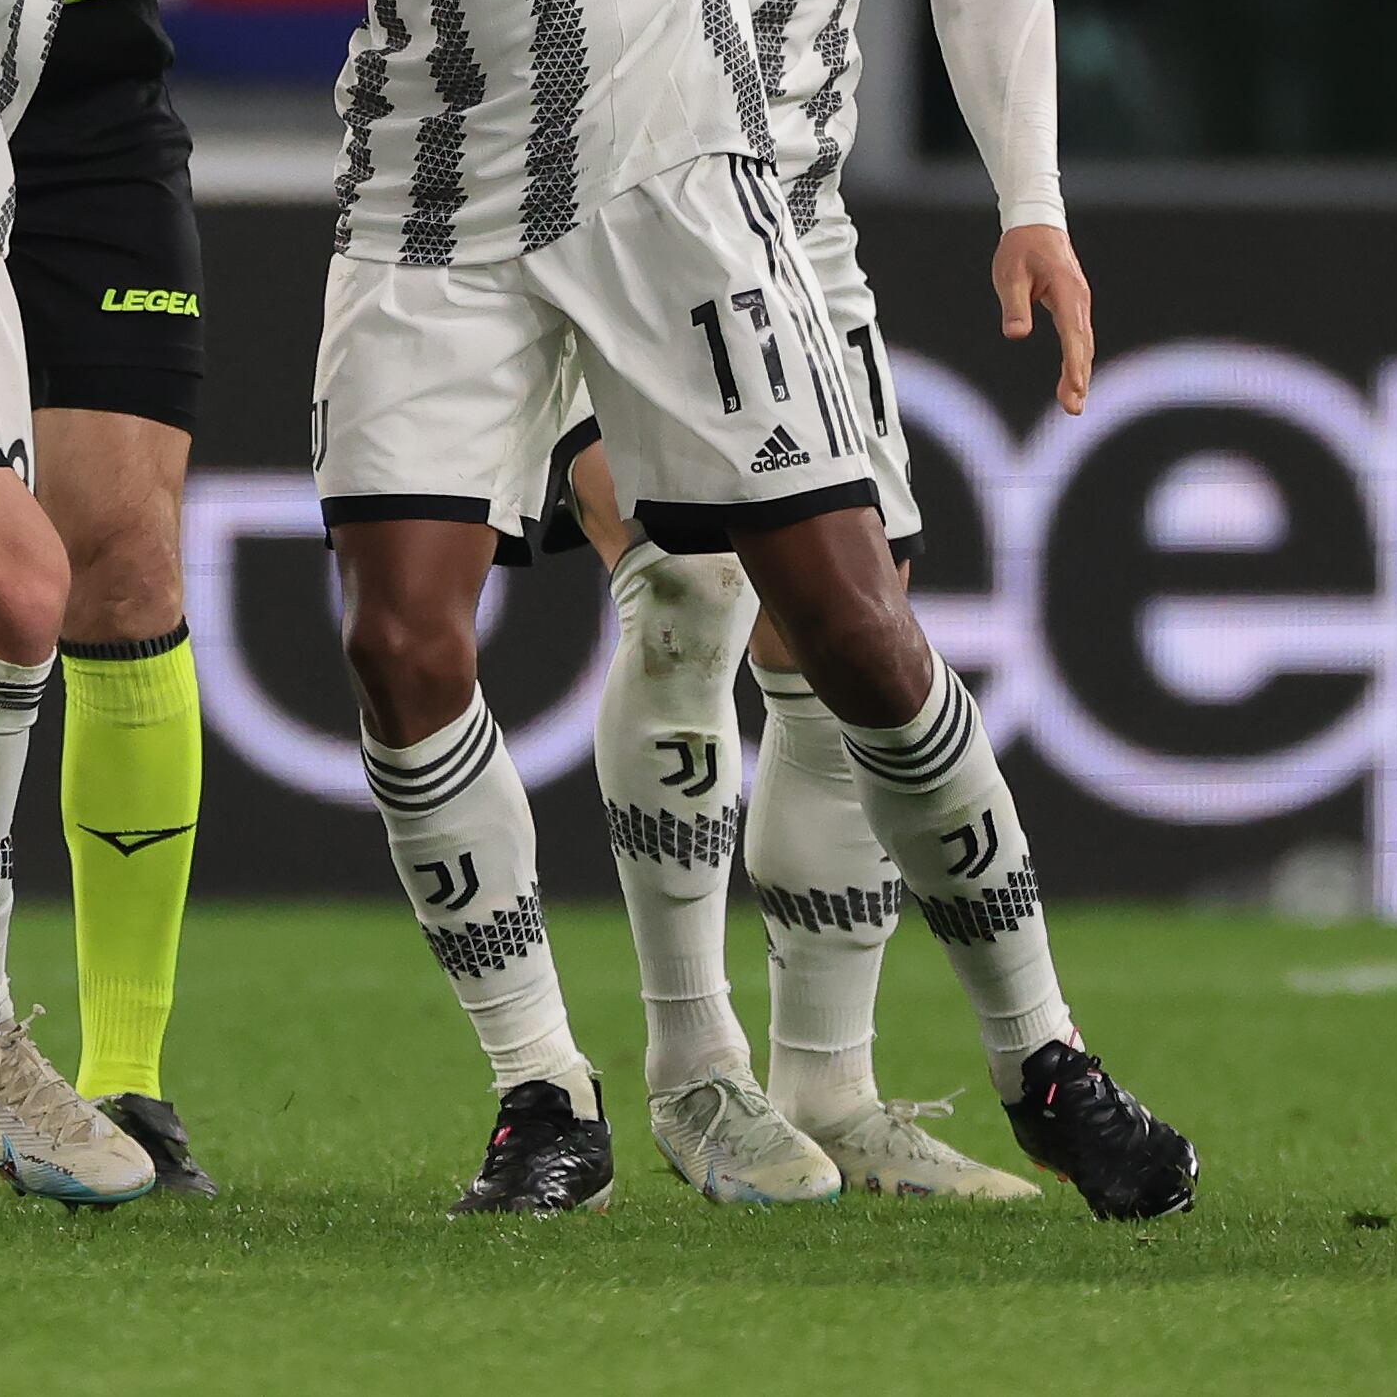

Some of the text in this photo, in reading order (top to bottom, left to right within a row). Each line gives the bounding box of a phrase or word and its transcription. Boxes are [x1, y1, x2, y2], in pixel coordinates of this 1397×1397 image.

[101, 288, 201, 318] LEGEA
[690, 288, 792, 415] 11
[846, 323, 889, 438] 1
[750, 451, 812, 474] adidas
